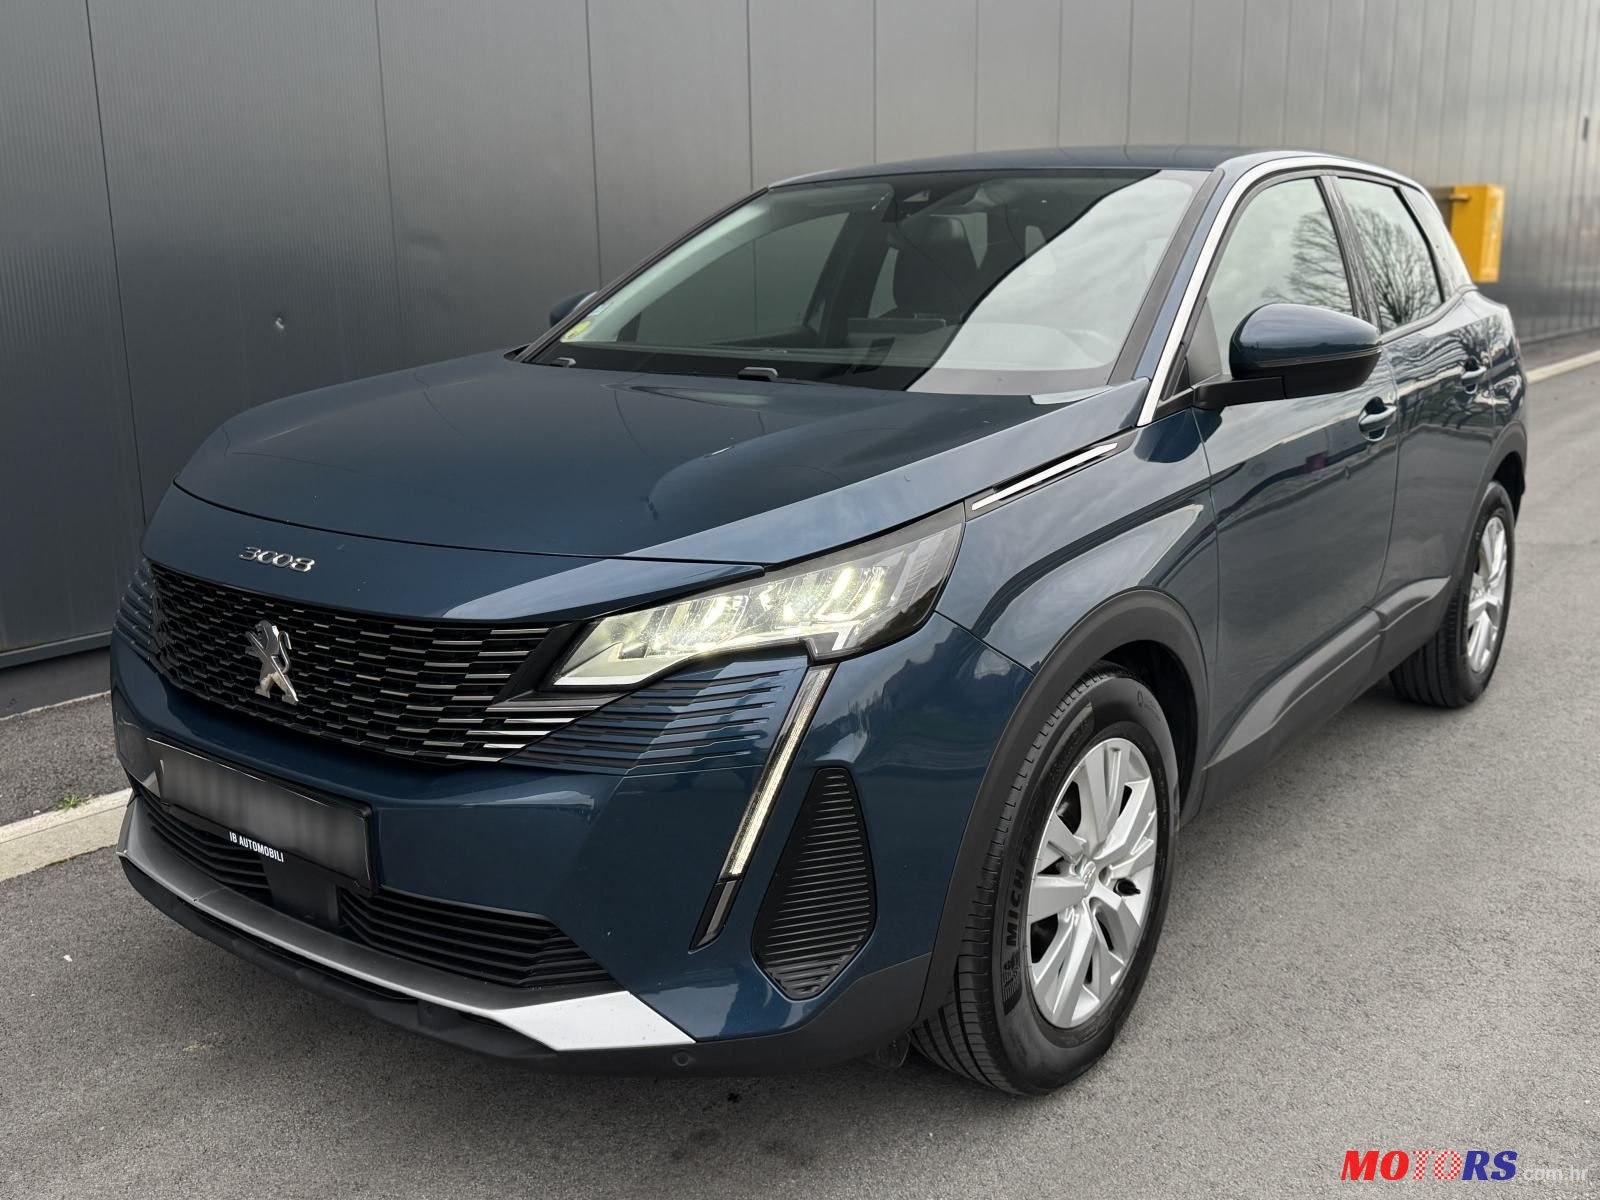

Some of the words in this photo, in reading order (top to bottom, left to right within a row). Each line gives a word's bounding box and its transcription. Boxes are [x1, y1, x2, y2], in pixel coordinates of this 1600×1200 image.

[239, 546, 315, 572] 3008
[229, 831, 238, 843] IB
[239, 835, 284, 863] AUTOMOBILI
